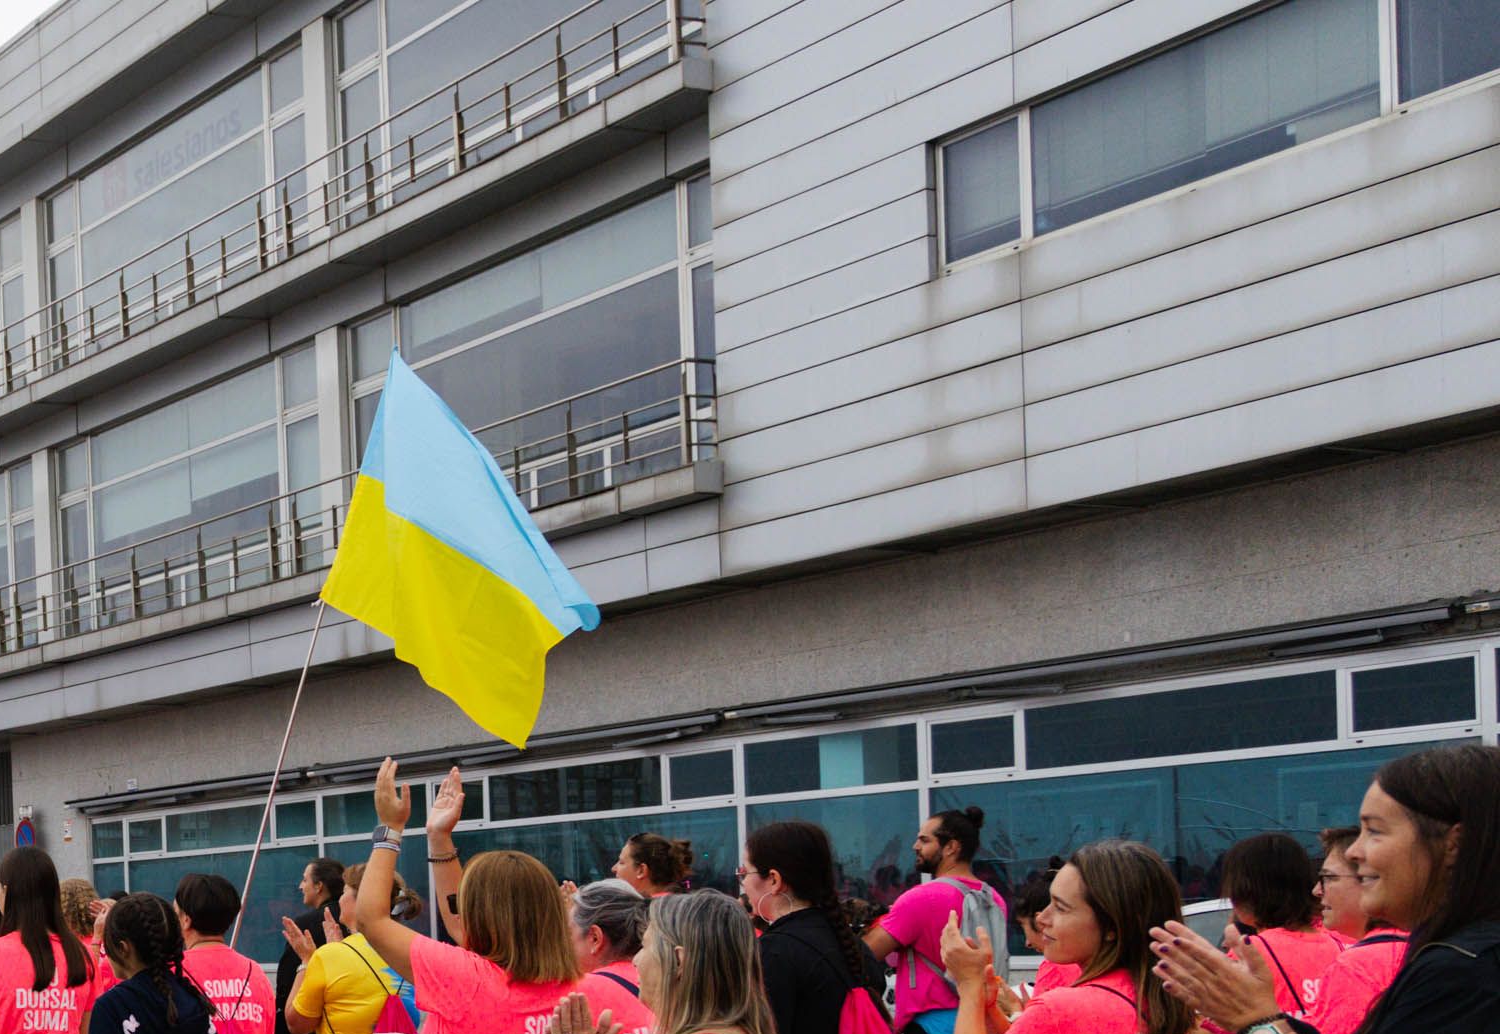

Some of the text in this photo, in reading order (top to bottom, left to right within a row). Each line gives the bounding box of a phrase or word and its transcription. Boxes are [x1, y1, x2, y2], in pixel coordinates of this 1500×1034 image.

[133, 109, 242, 188] salesianos
[204, 978, 252, 999] SOMOS
[23, 1010, 69, 1032] SUMA
